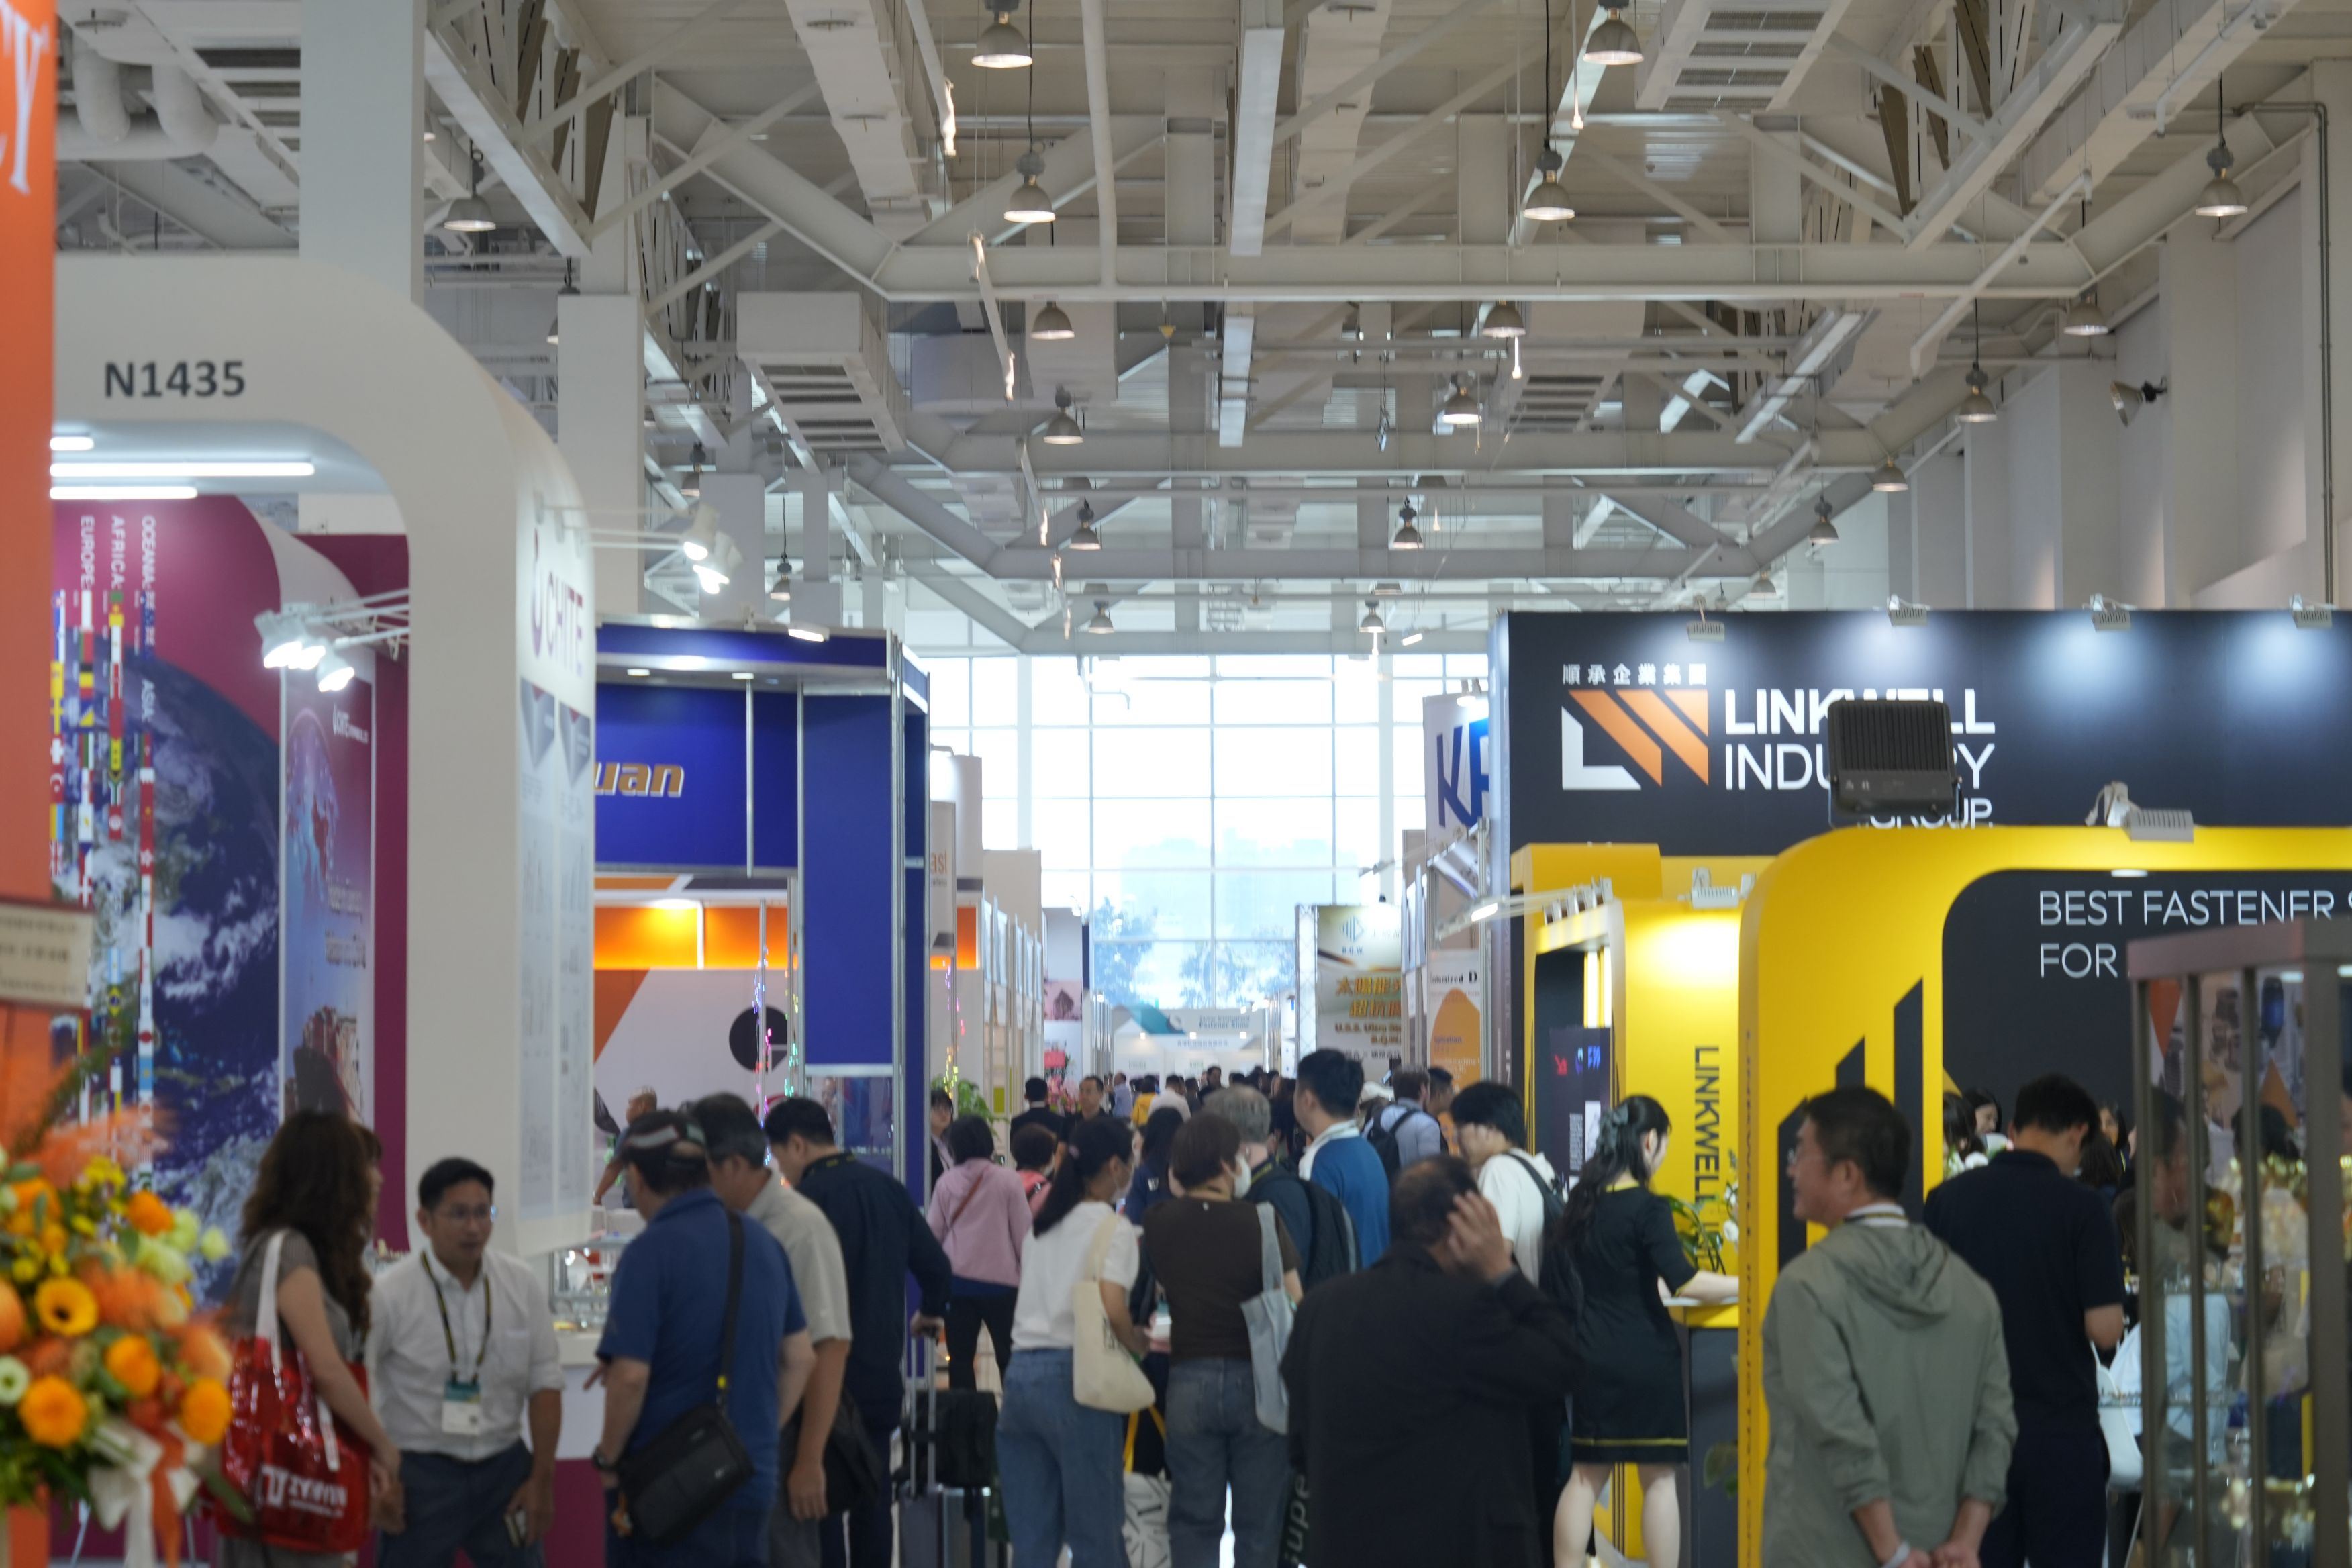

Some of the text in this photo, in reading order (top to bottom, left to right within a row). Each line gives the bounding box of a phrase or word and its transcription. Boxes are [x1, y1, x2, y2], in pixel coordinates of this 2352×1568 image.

[105, 361, 246, 397] N1435
[1725, 688, 1996, 734] LINKL
[2041, 890, 2133, 926] BEST
[2143, 890, 2335, 926] FASTENER
[2041, 942, 2118, 978] FOR
[1695, 1046, 1720, 1204] LINKWELL
